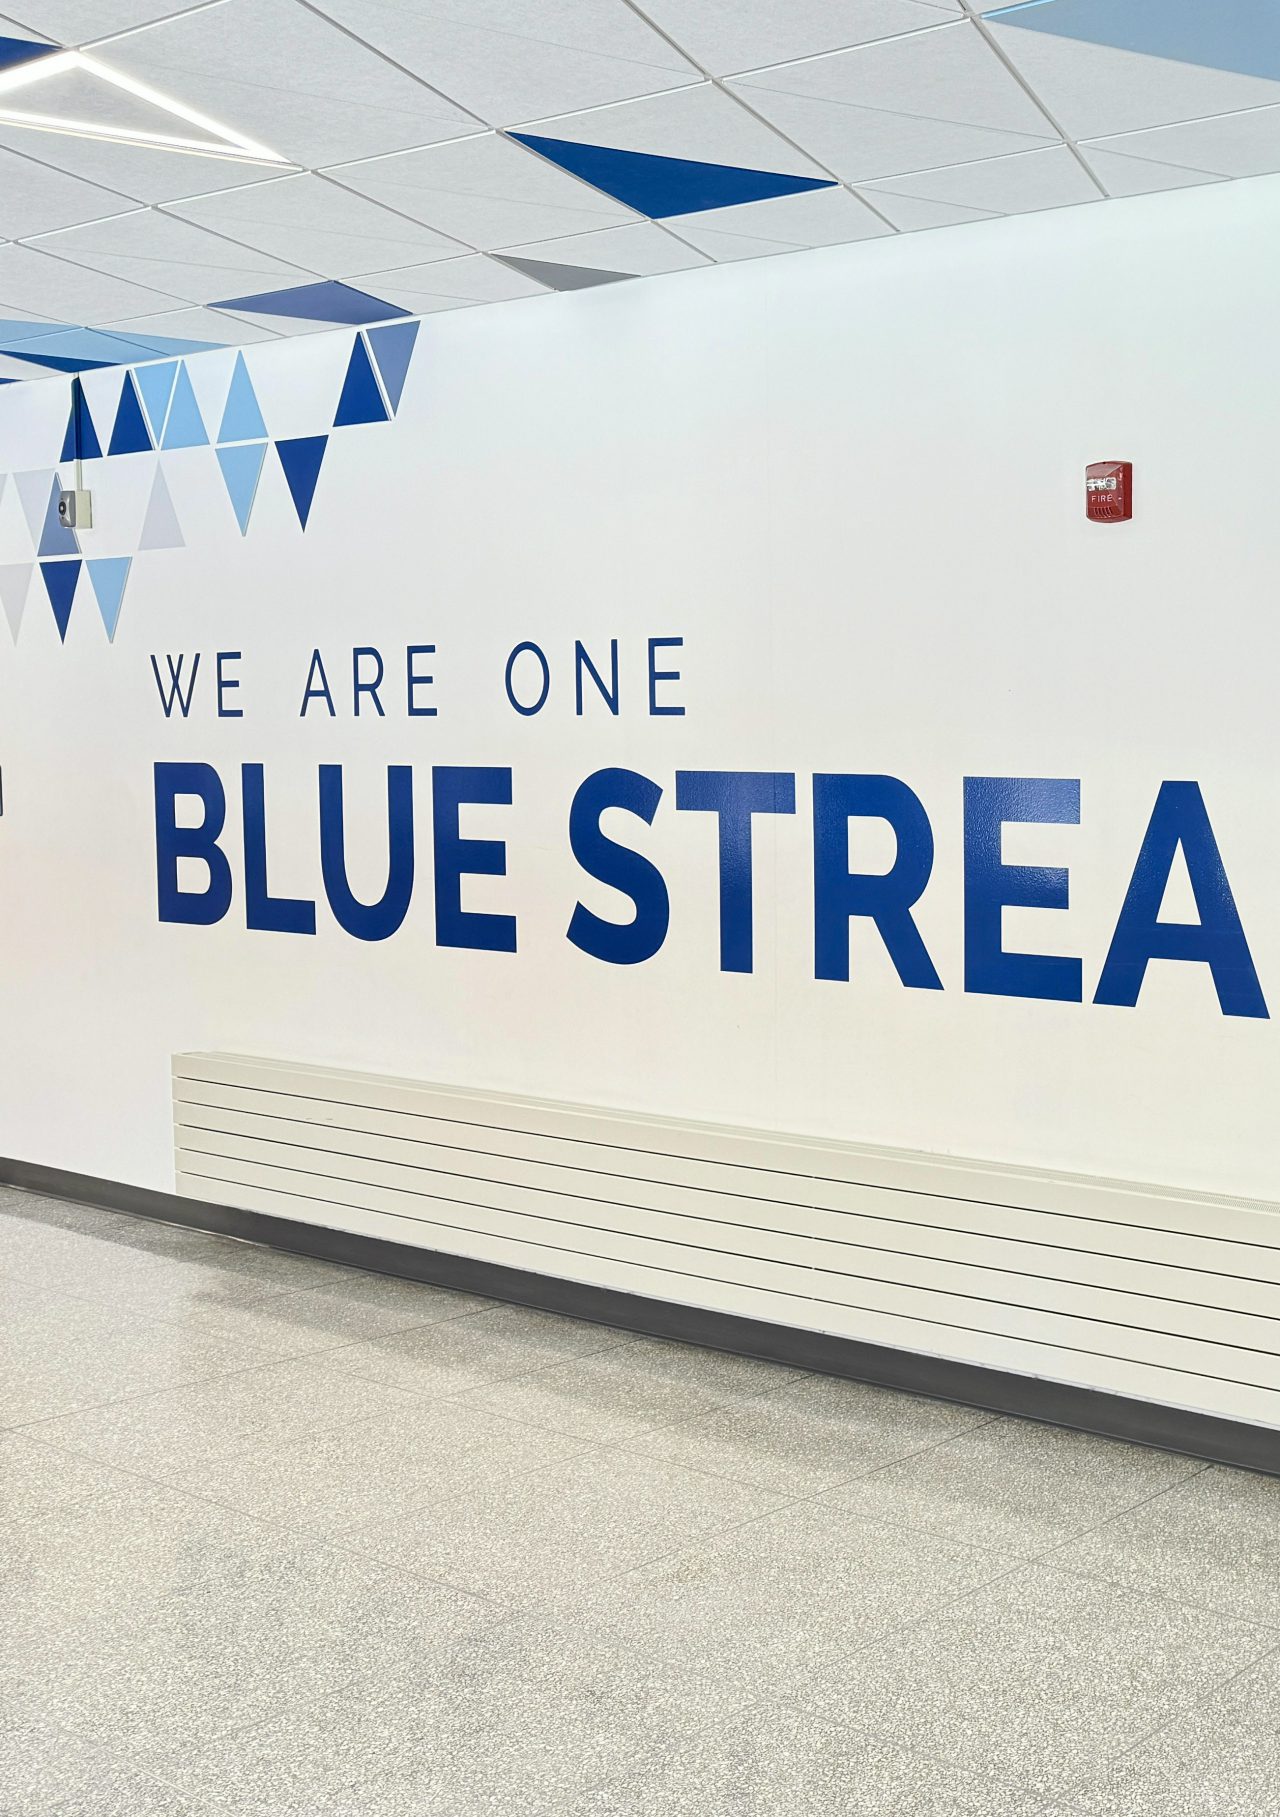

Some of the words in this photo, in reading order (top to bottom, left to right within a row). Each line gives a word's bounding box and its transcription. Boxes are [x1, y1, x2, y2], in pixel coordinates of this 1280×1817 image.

[1091, 494, 1113, 503] FIRE
[150, 651, 243, 718] WE
[299, 644, 439, 718] ARE
[504, 636, 687, 717] ONE
[154, 762, 517, 953] BLUE
